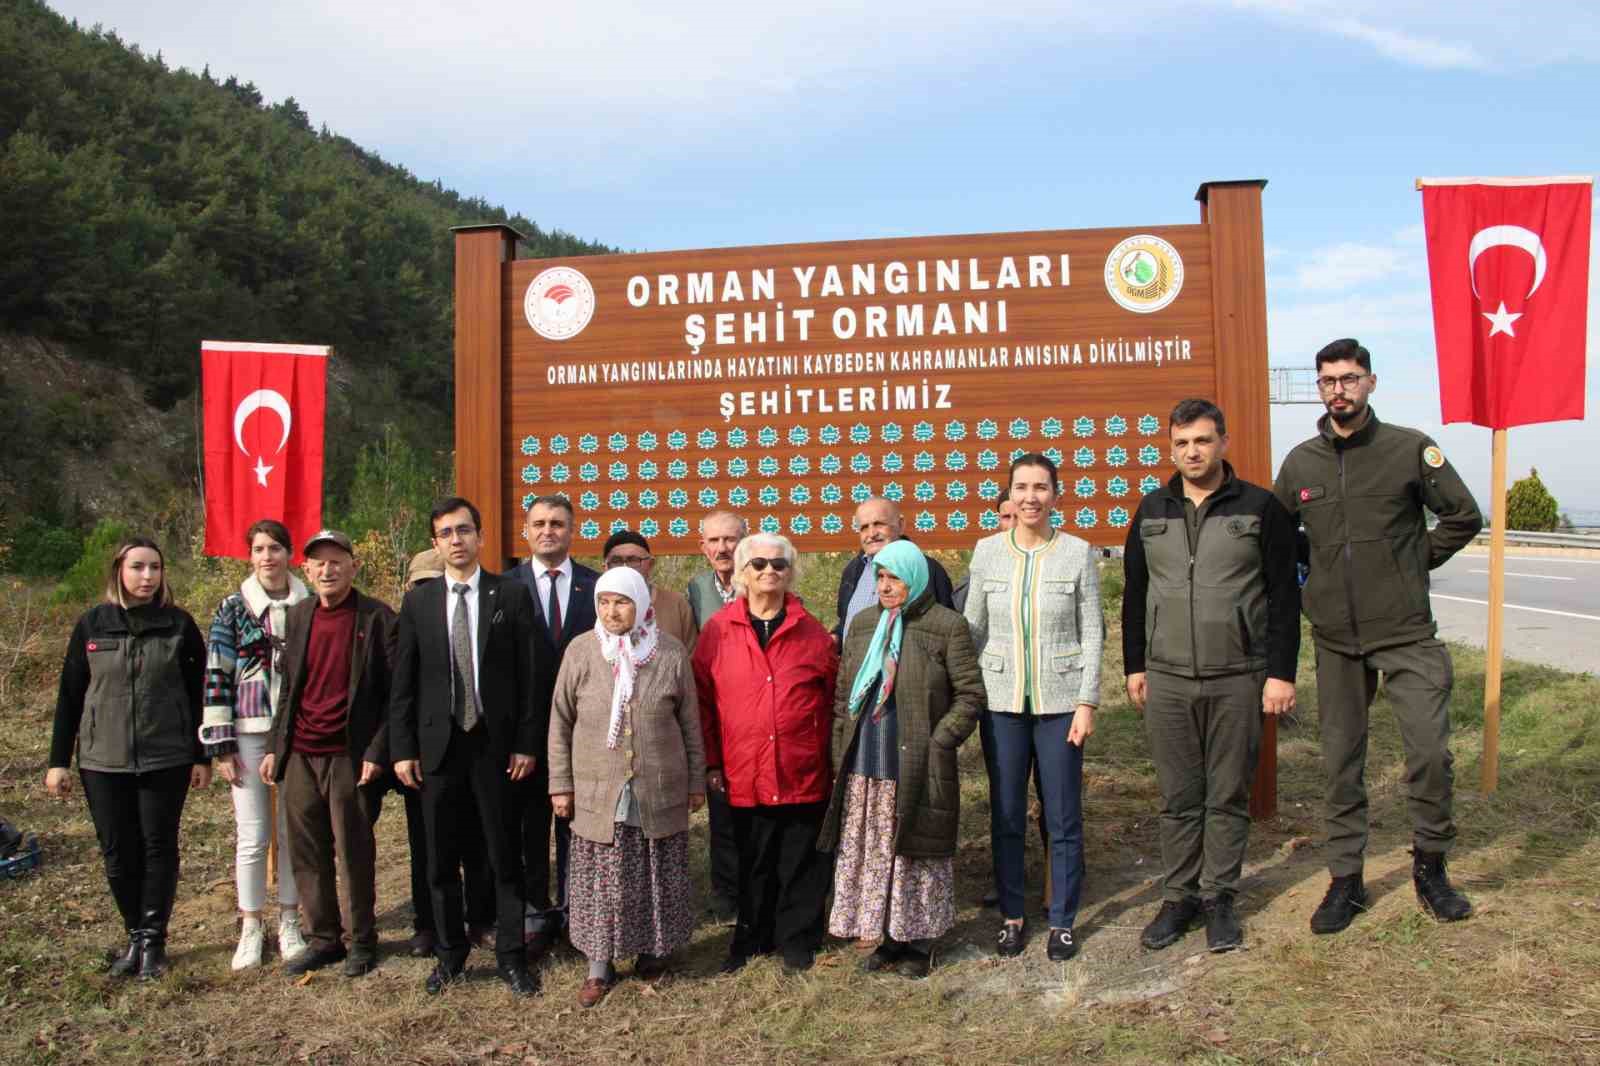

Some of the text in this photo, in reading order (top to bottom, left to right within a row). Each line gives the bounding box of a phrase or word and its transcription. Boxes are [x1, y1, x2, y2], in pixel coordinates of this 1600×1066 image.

[627, 268, 775, 308] ORMAN
[791, 254, 1071, 299] YANGINLARI
[684, 299, 1008, 355] ŞEHİT ORMANI
[547, 335, 1192, 385] ORMAN YANGINLARINDA HAYATINI KAYBEDEN KAHRAMANLAR ANISINA DİKİLMİŞTİR
[719, 379, 952, 423] ŞEHİTLERİMİZ
